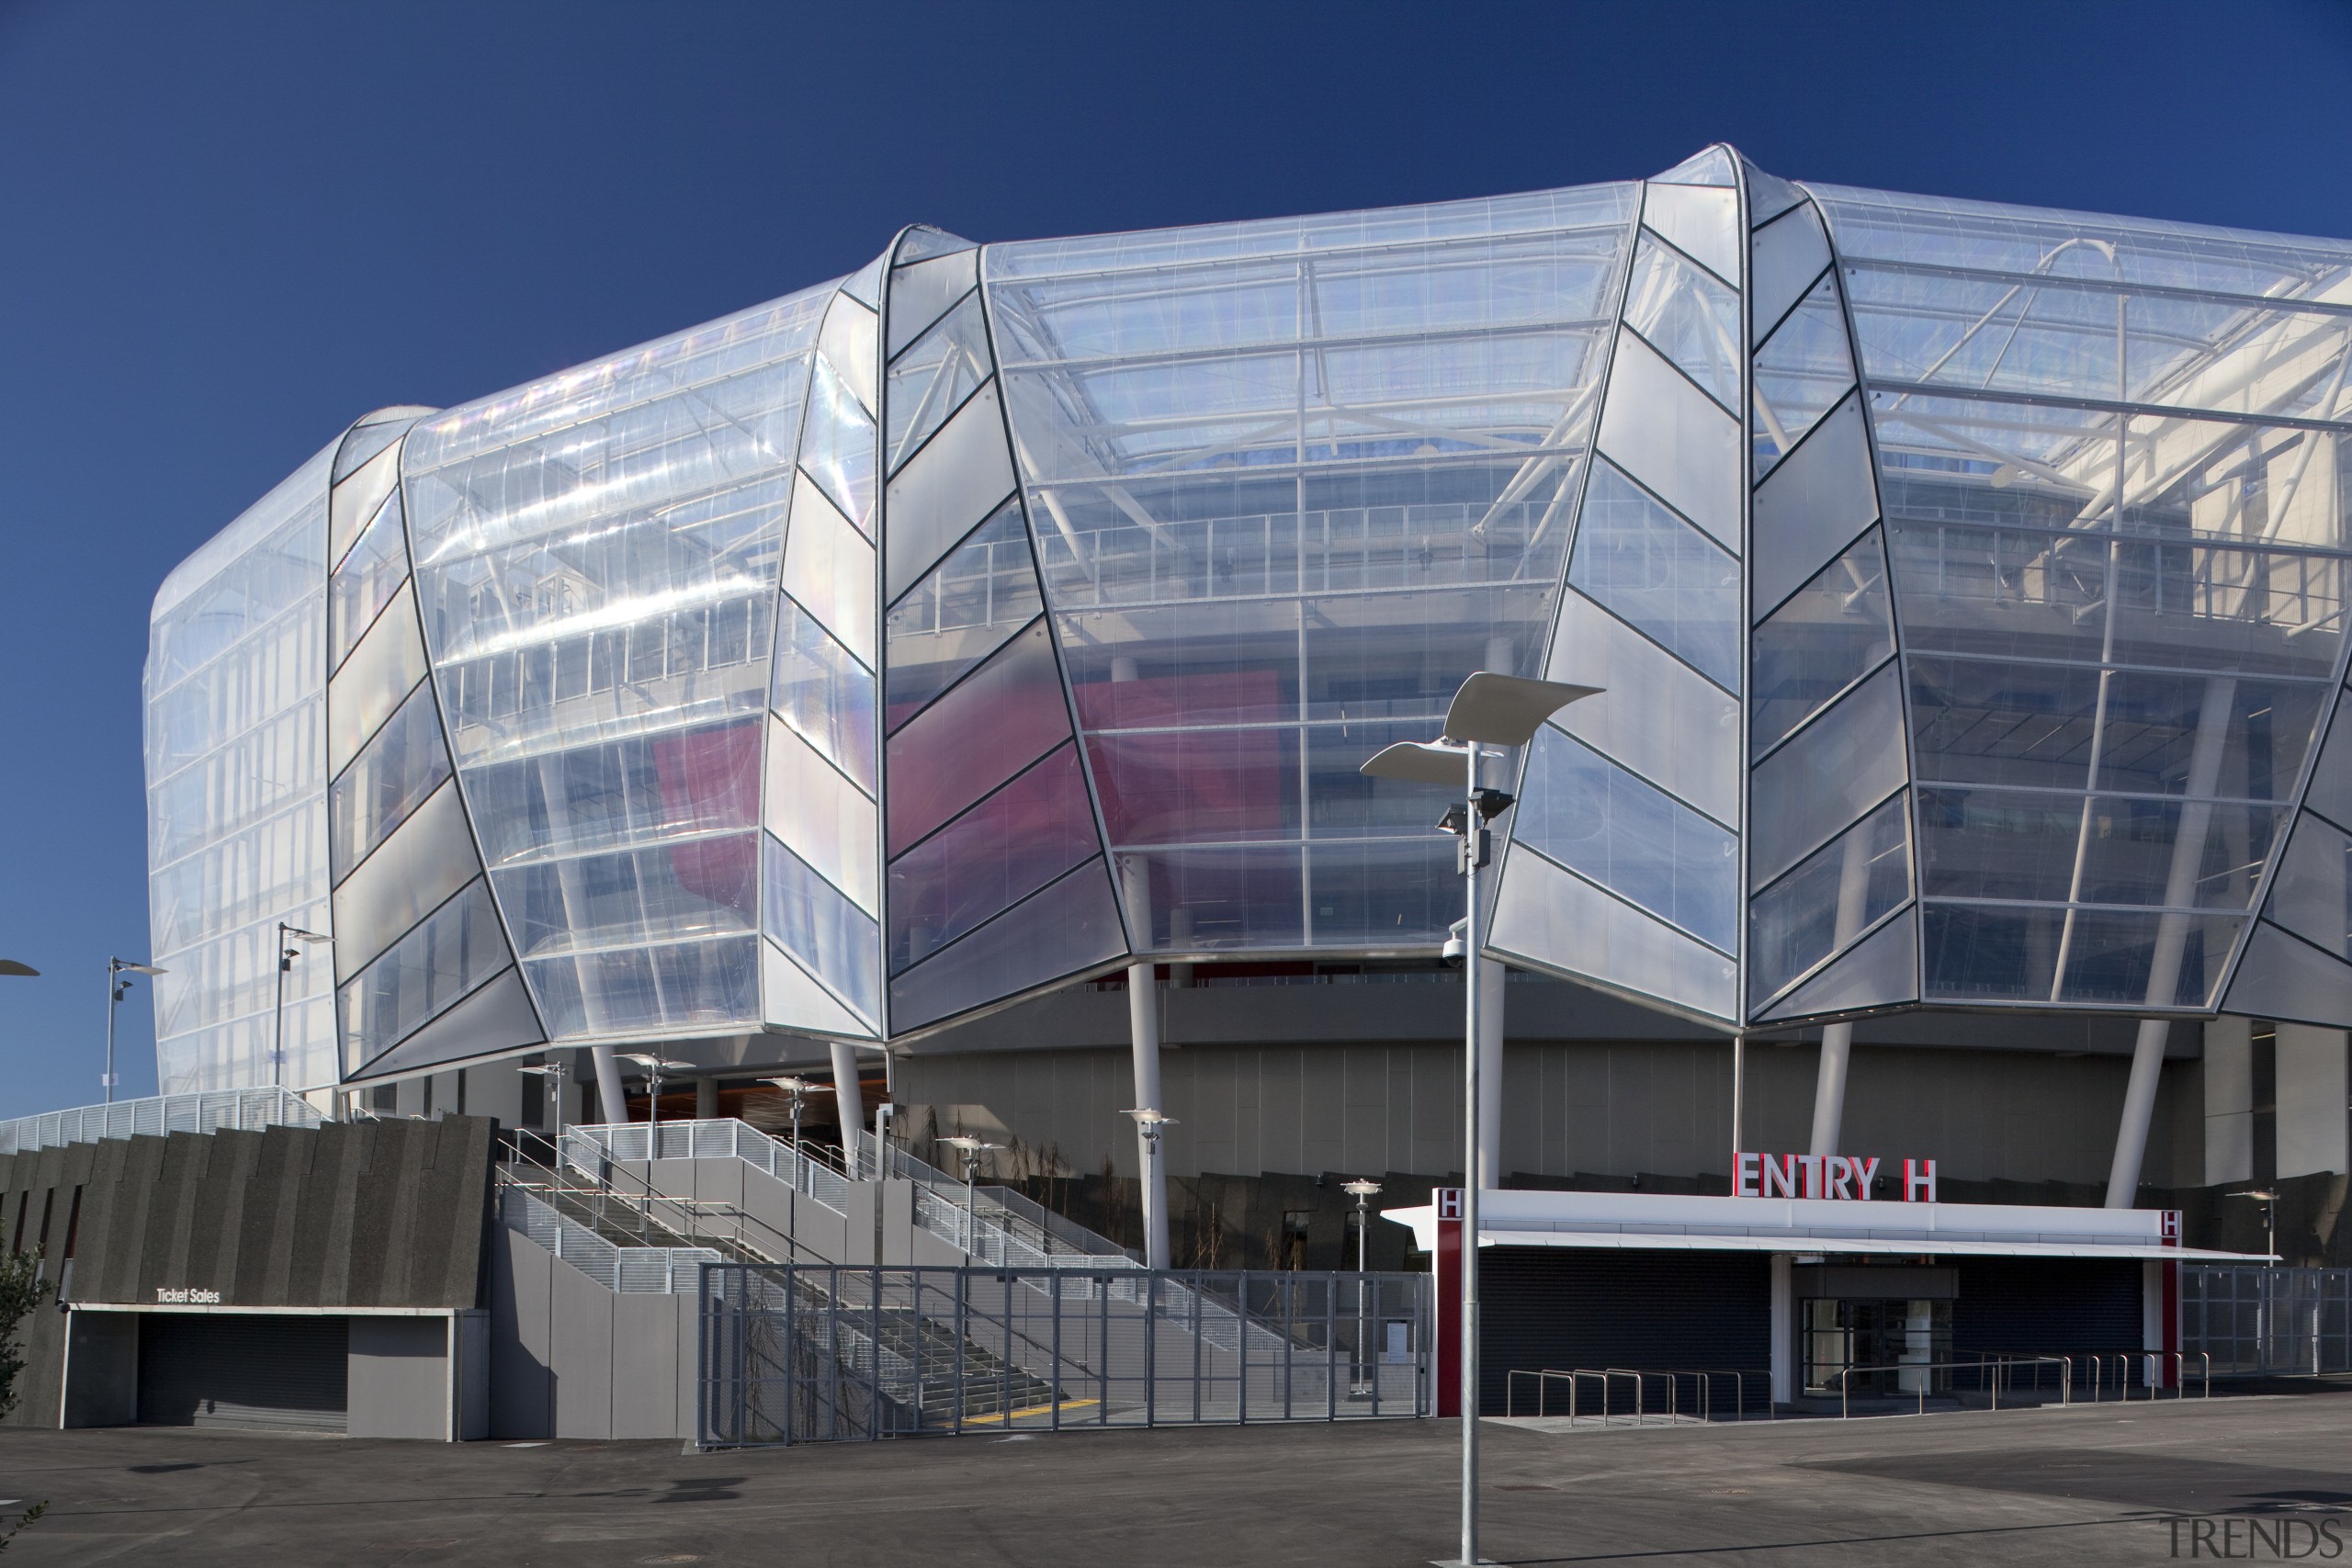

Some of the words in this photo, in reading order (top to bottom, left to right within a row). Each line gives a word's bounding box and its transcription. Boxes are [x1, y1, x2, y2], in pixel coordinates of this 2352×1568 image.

[1734, 1152, 1880, 1201] ENTRY
[1904, 1158, 1937, 1202] H
[1442, 1190, 1462, 1217] H
[2164, 1212, 2178, 1235] H
[156, 1288, 189, 1303] Ticket
[189, 1288, 220, 1303] Sales
